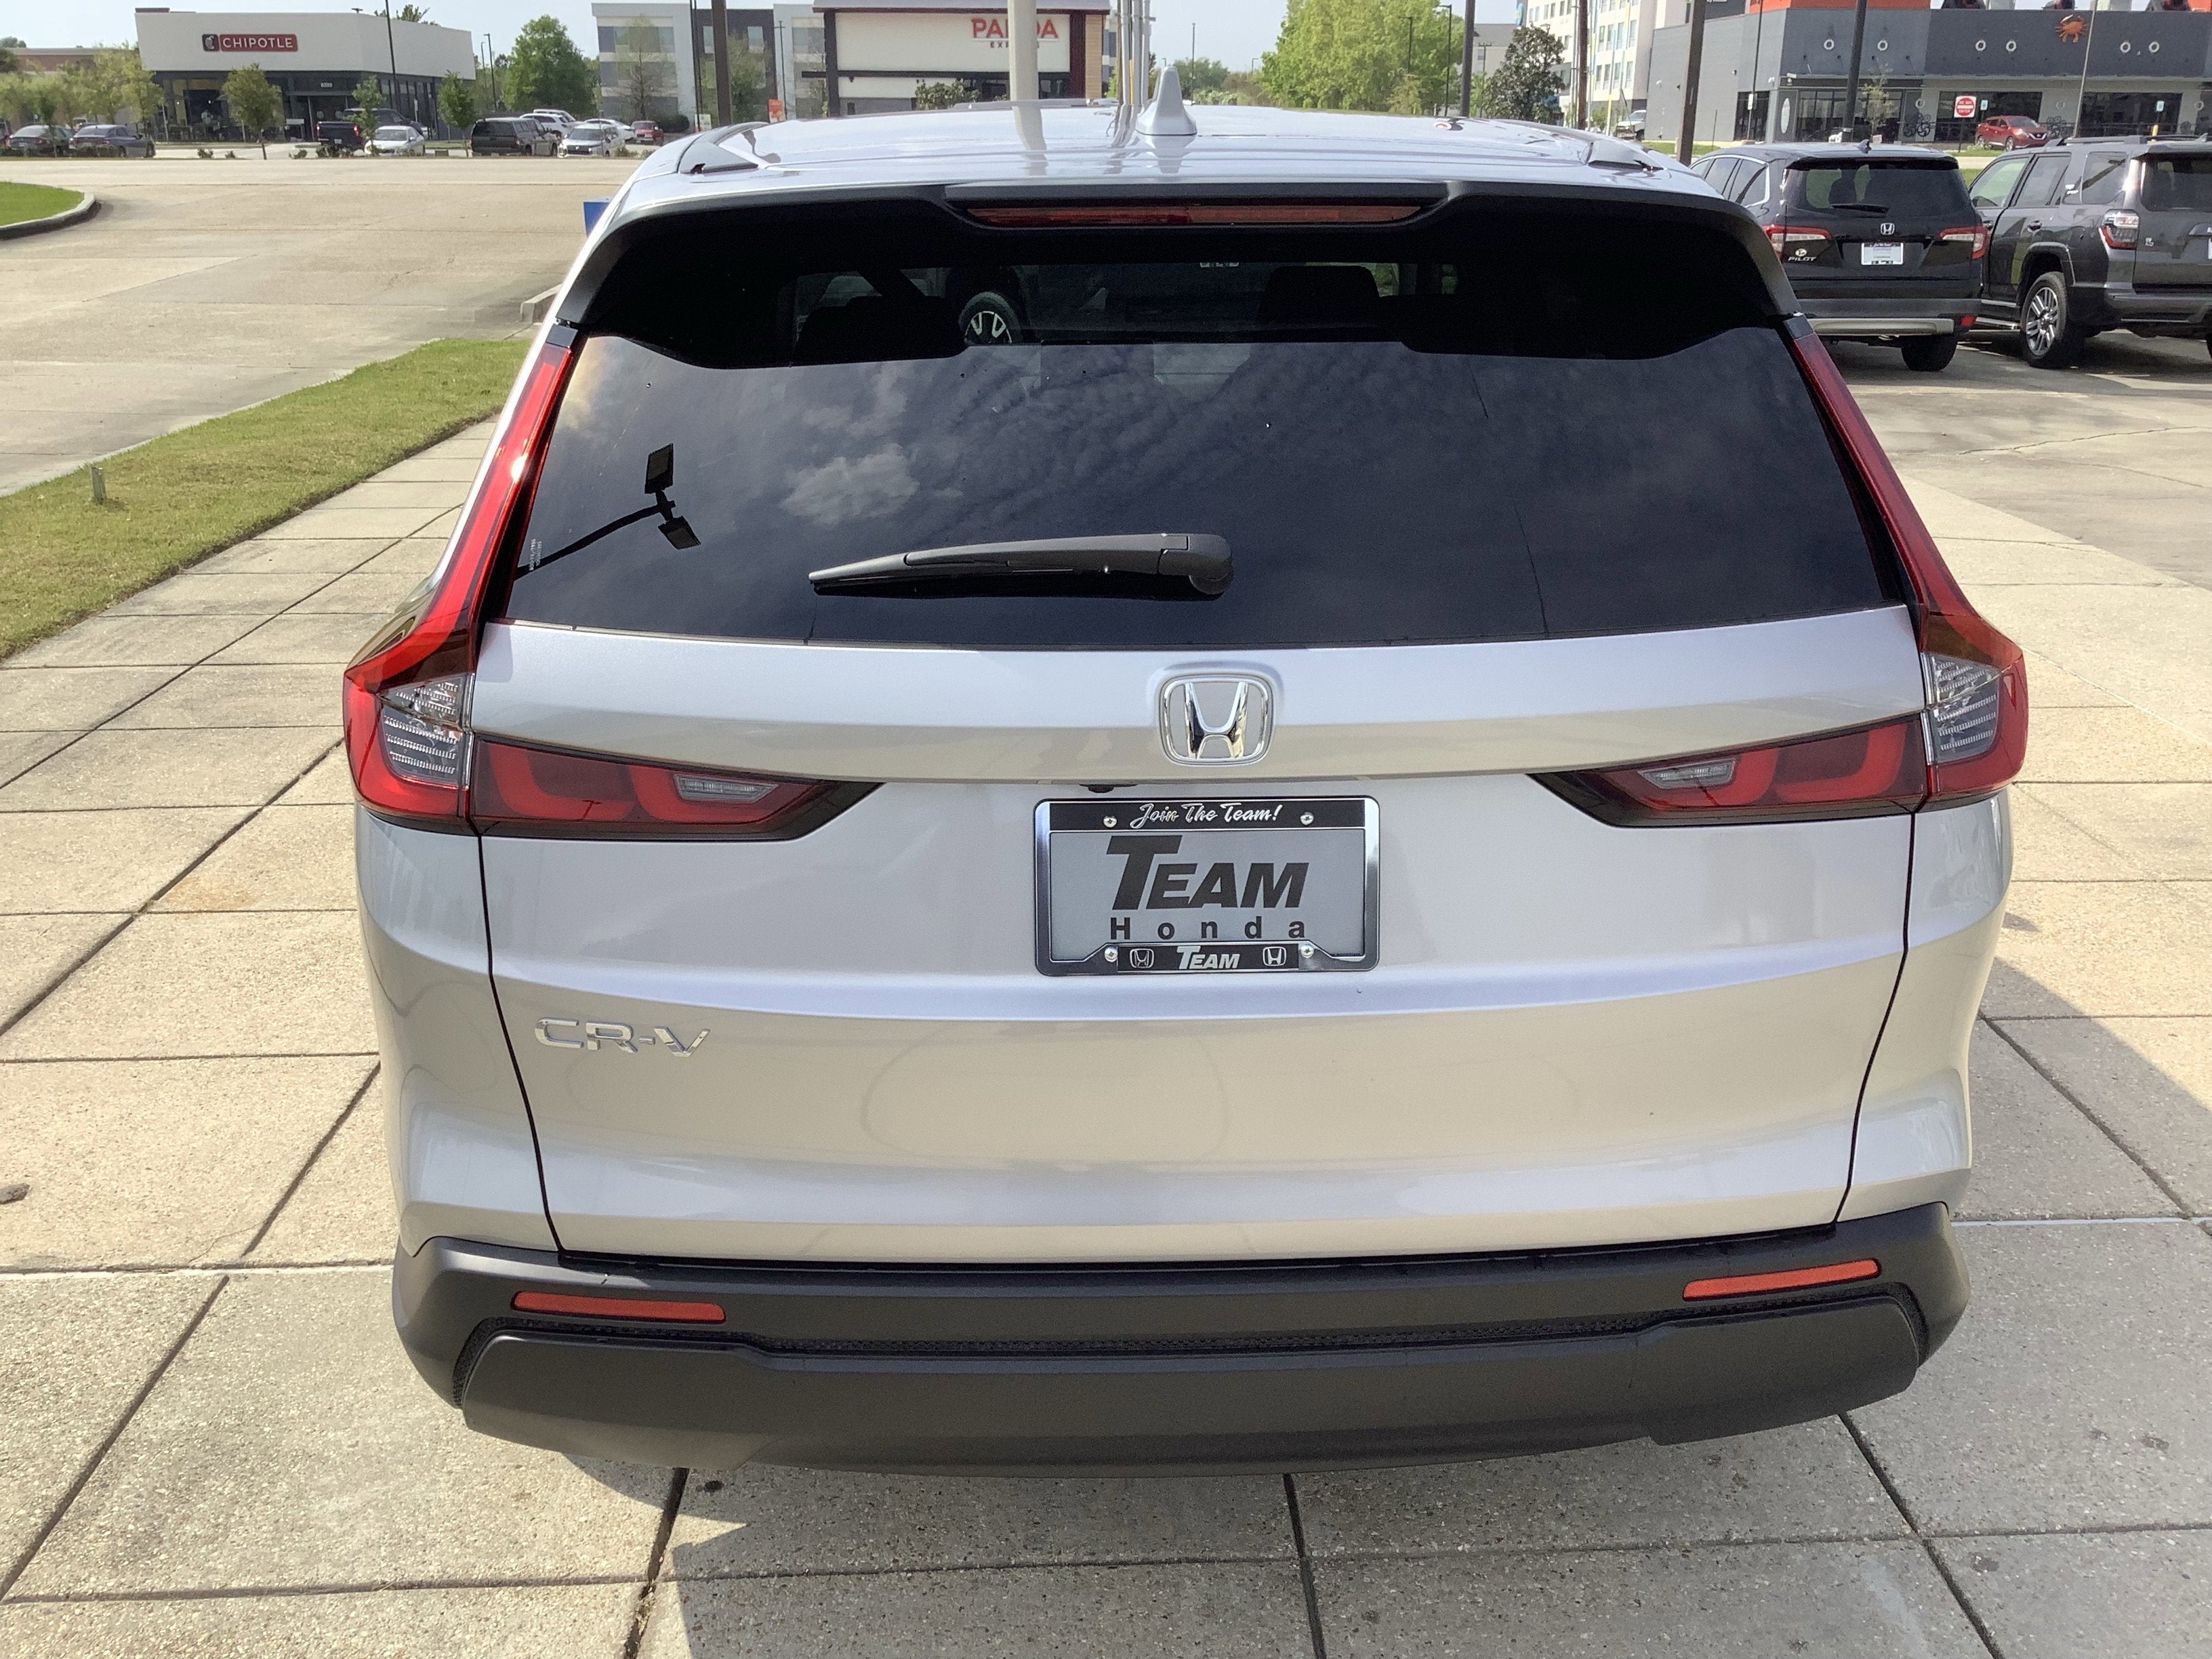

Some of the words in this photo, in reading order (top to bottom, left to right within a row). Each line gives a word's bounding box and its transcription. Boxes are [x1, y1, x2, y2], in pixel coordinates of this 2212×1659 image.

[971, 18, 1058, 39] PAA
[222, 37, 293, 48] CHIPOTLE
[1129, 802, 1179, 829] Join
[1181, 802, 1218, 823] The
[1220, 802, 1283, 823] Team!
[1106, 834, 1309, 910] TEAM
[1110, 916, 1305, 940] Honda
[1176, 945, 1241, 970] TEAM
[534, 1017, 711, 1058] CR-V
